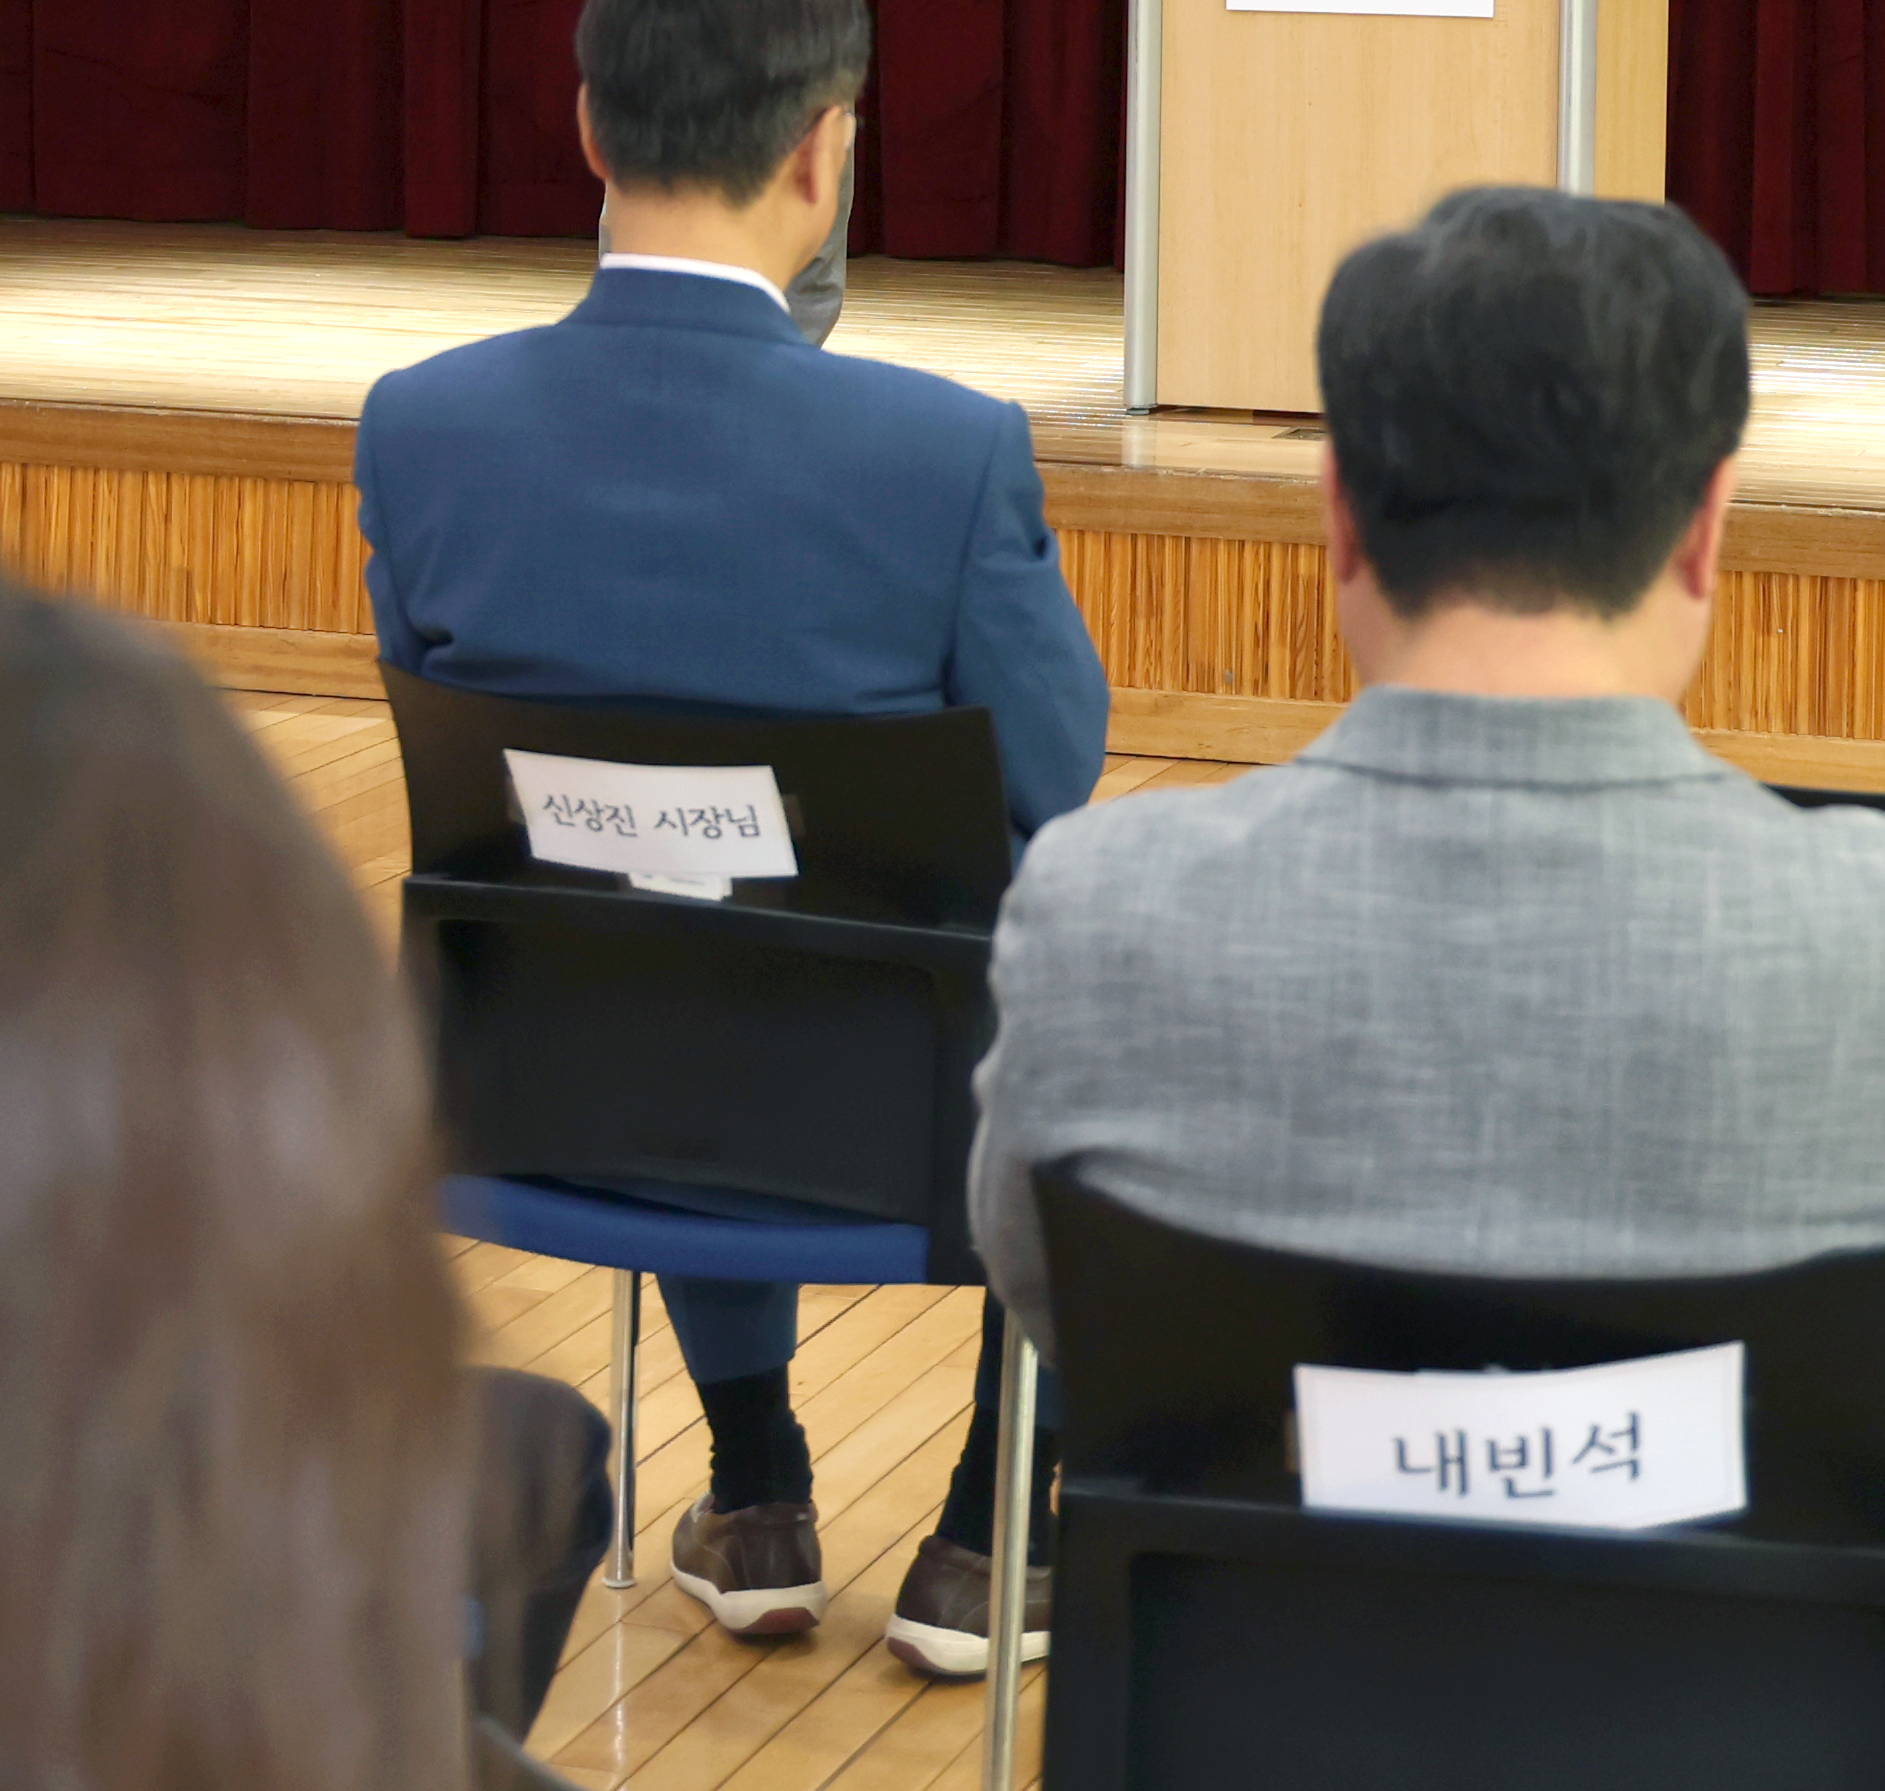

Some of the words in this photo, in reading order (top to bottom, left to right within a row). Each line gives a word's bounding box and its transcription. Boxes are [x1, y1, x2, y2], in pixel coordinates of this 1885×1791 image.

[542, 793, 639, 838] 신상진
[653, 805, 762, 839] 시장님
[1391, 1410, 1643, 1501] 내빈석
